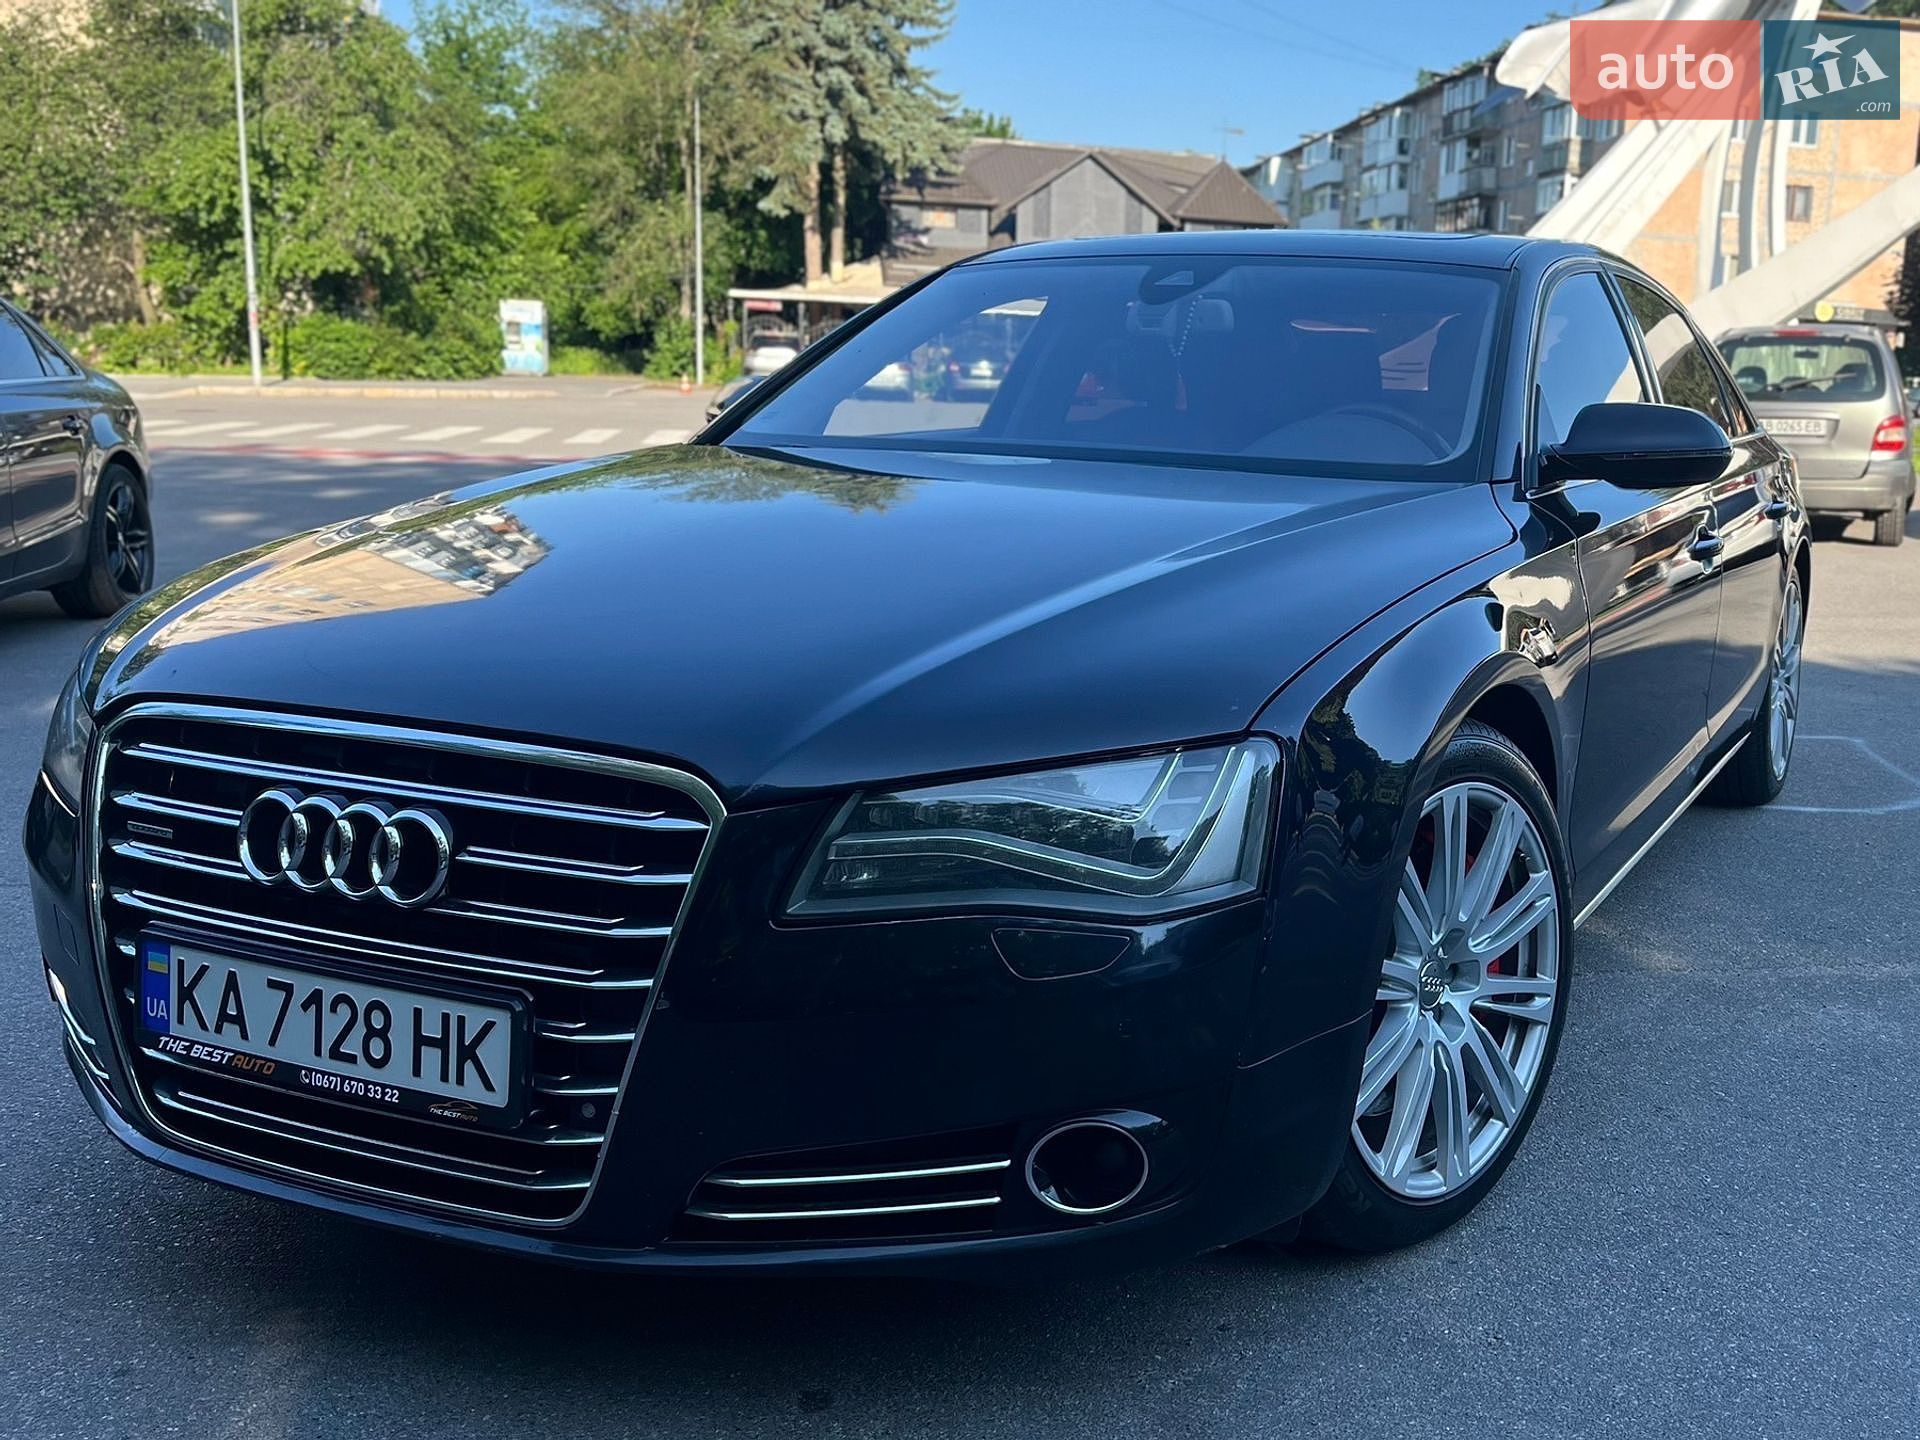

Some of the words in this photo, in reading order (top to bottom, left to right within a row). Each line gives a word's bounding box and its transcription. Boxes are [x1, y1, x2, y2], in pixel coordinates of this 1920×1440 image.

[146, 996, 169, 1020] UA
[176, 958, 249, 1041] KA
[265, 977, 393, 1069] 7128
[411, 1006, 497, 1092] HK
[158, 1036, 190, 1055] THE
[311, 1071, 341, 1092] (067)
[343, 1079, 365, 1096] 670
[367, 1084, 382, 1099] 33
[384, 1088, 399, 1103] 22
